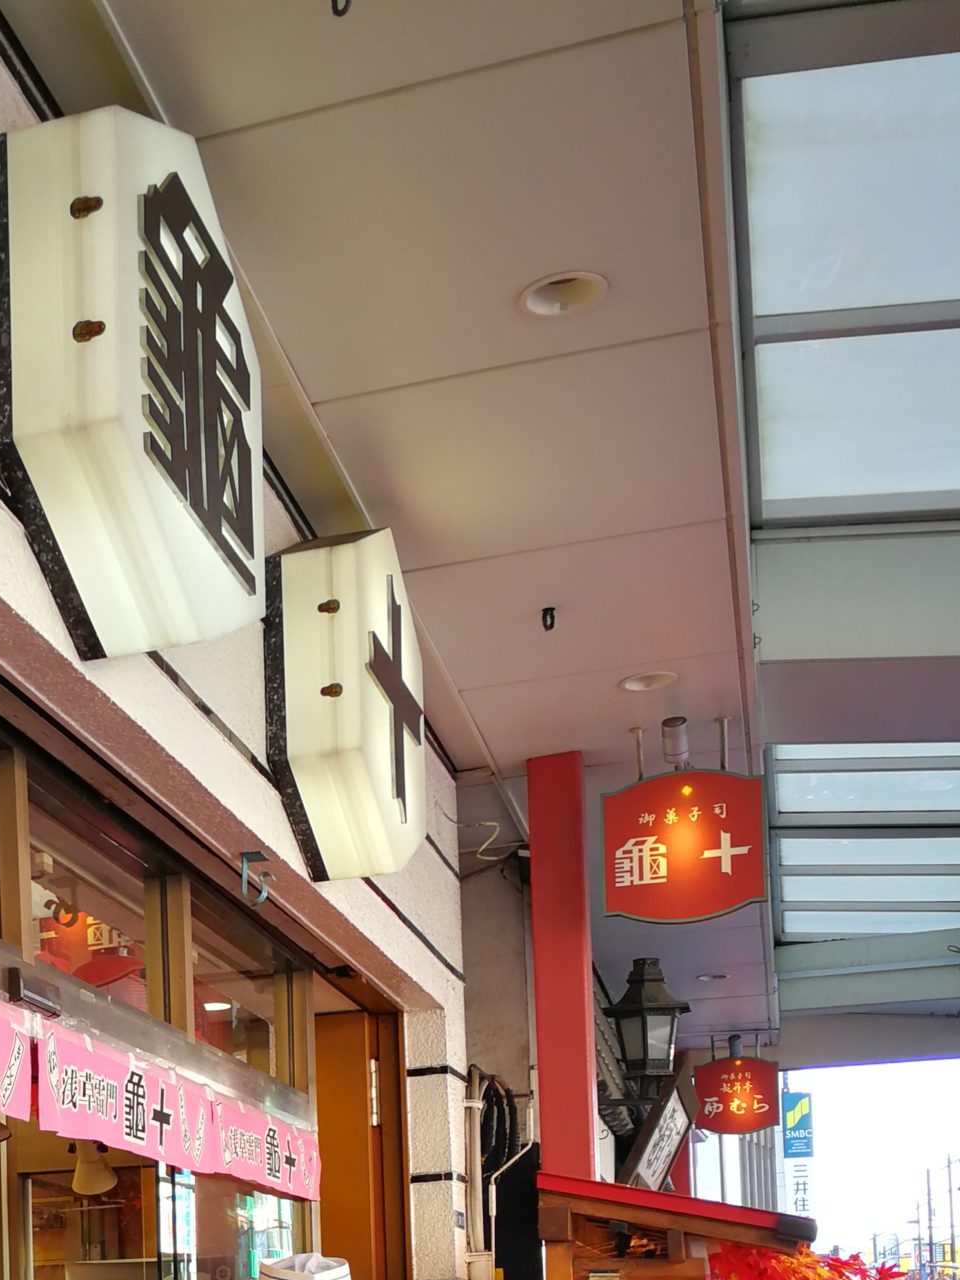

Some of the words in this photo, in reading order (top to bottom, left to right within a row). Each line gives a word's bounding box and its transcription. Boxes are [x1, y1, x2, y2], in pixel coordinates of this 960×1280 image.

[638, 802, 728, 827] 御菓子司
[61, 1067, 118, 1121] 浅草雷門
[785, 1129, 813, 1139] SMBC
[792, 1164, 810, 1216] 三井住
